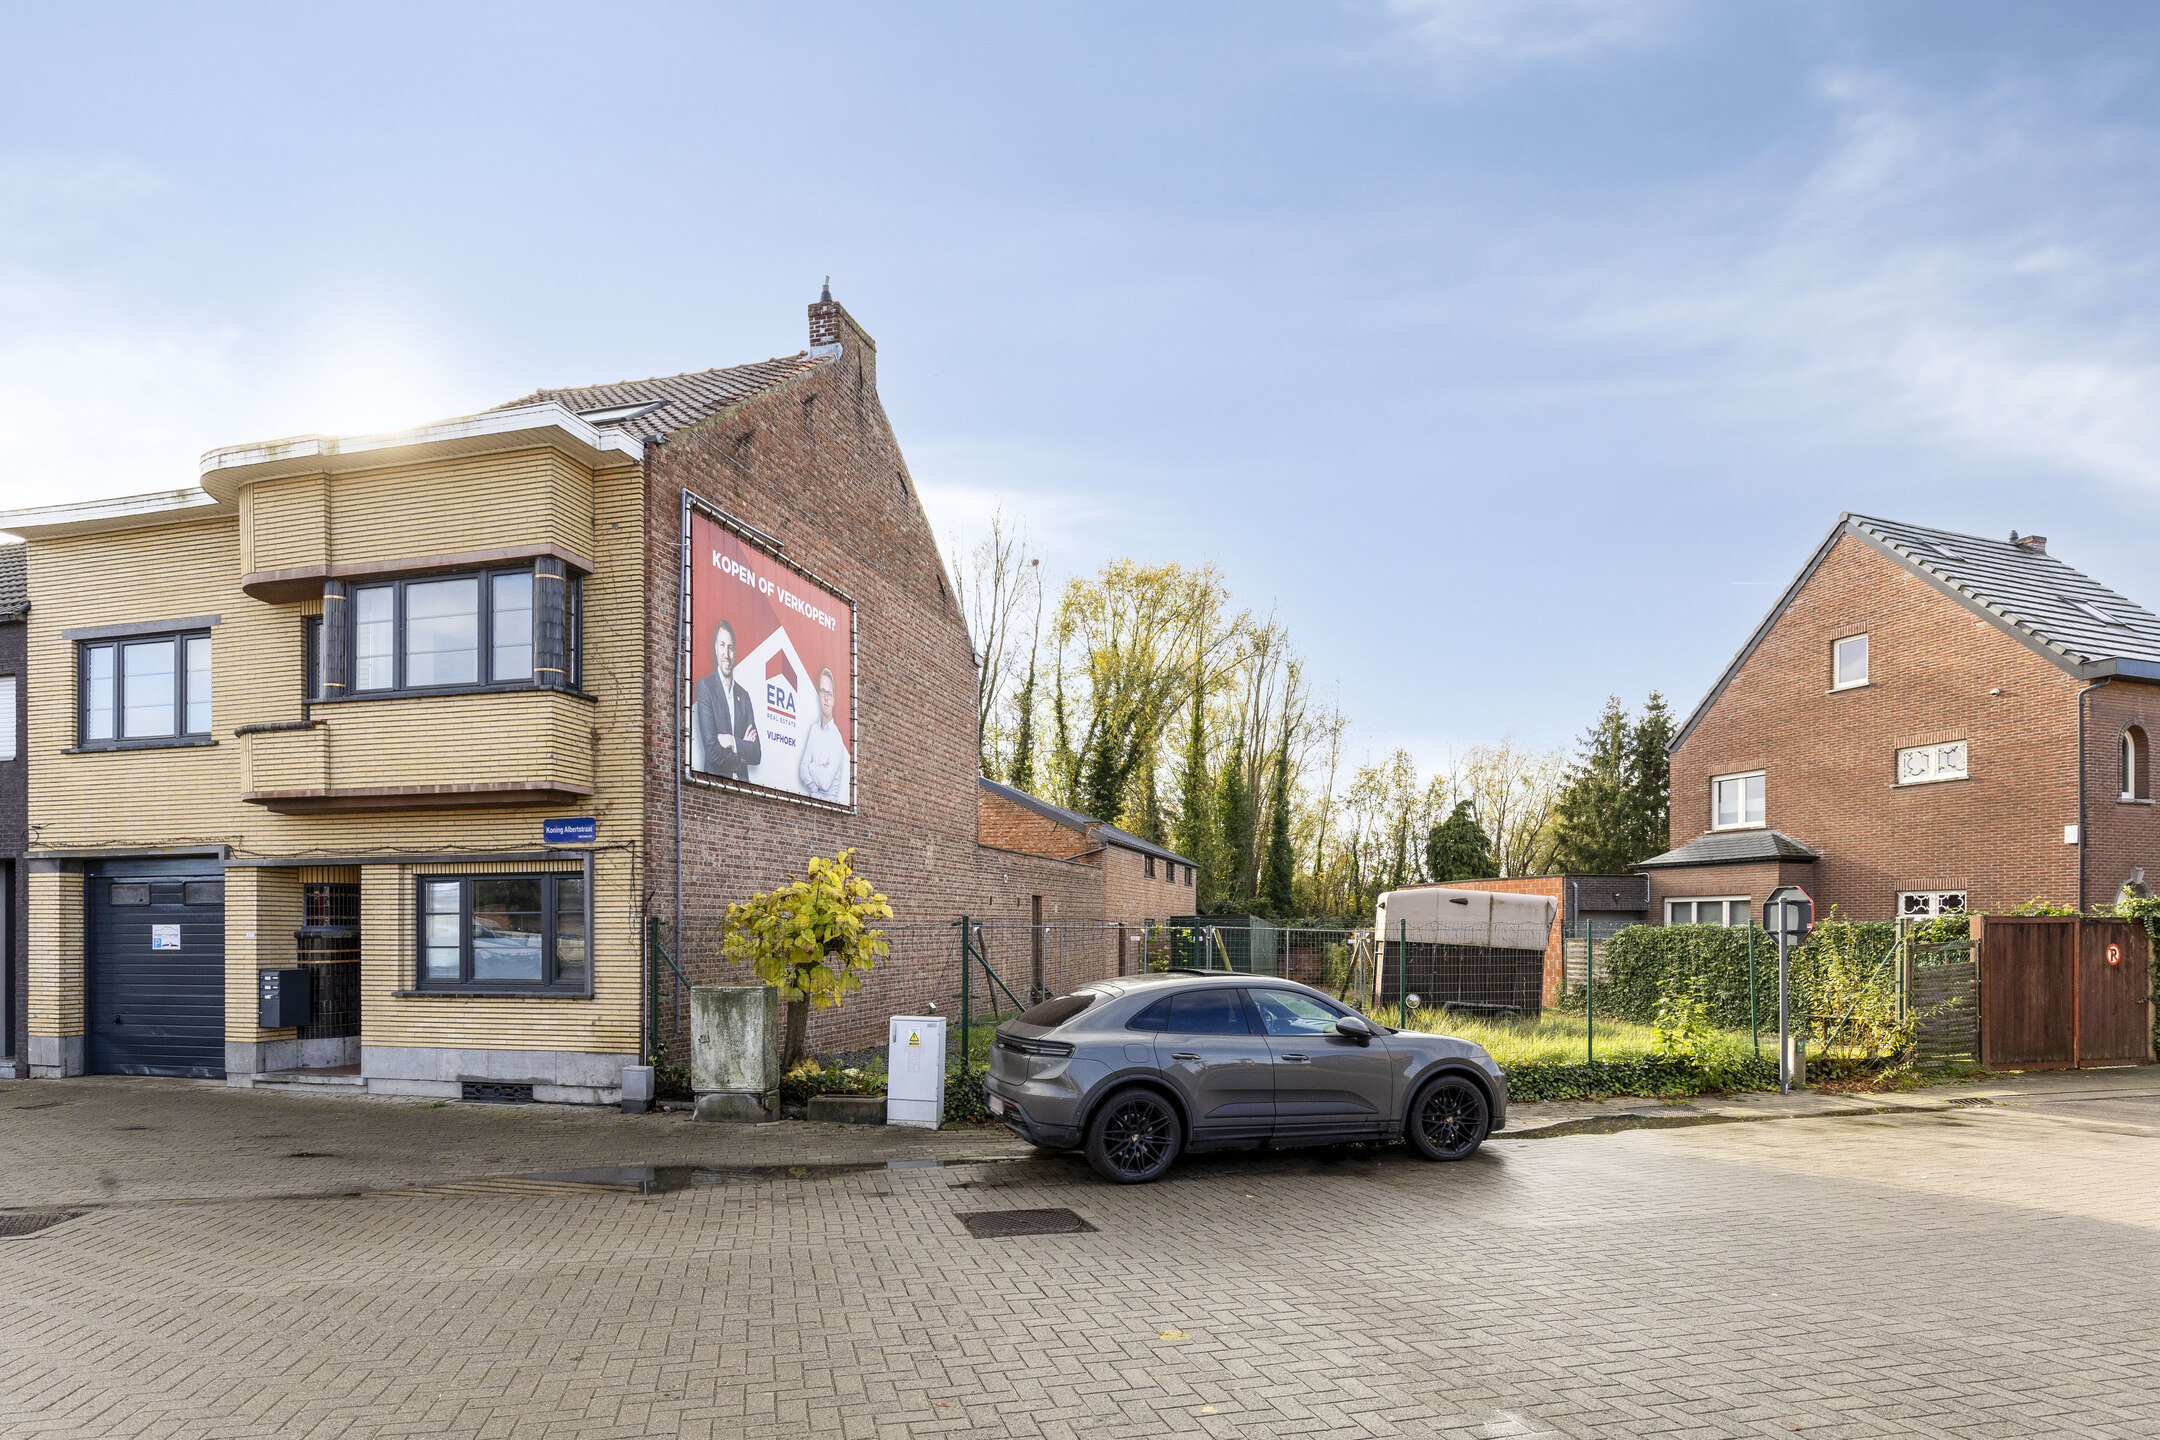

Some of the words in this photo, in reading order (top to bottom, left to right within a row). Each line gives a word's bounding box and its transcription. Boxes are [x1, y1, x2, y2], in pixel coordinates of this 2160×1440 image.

[712, 549, 756, 588] KOPEN
[758, 576, 775, 597] OF
[776, 585, 836, 631] VERKOPEN?
[767, 683, 796, 713] ERA
[767, 712, 779, 722] REAL
[780, 717, 796, 728] ESTATE
[766, 729, 797, 748] VIJFHOEK
[546, 826, 564, 835] Koning
